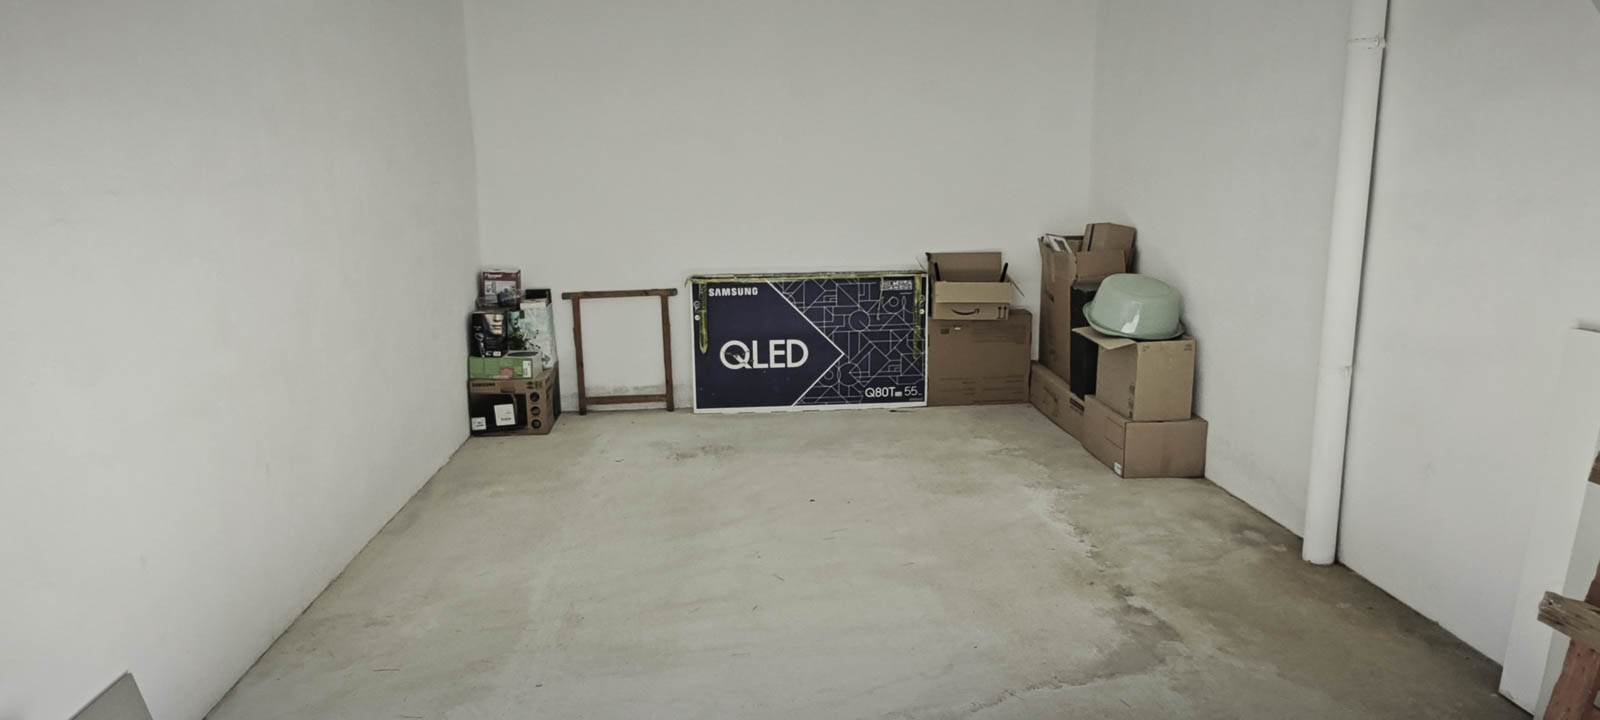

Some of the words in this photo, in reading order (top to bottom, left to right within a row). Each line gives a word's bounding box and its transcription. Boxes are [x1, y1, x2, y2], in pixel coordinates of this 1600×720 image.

[708, 286, 759, 297] SAMSUNG
[719, 339, 809, 370] QLED
[864, 386, 896, 398] Q80T
[904, 386, 918, 397] 55
